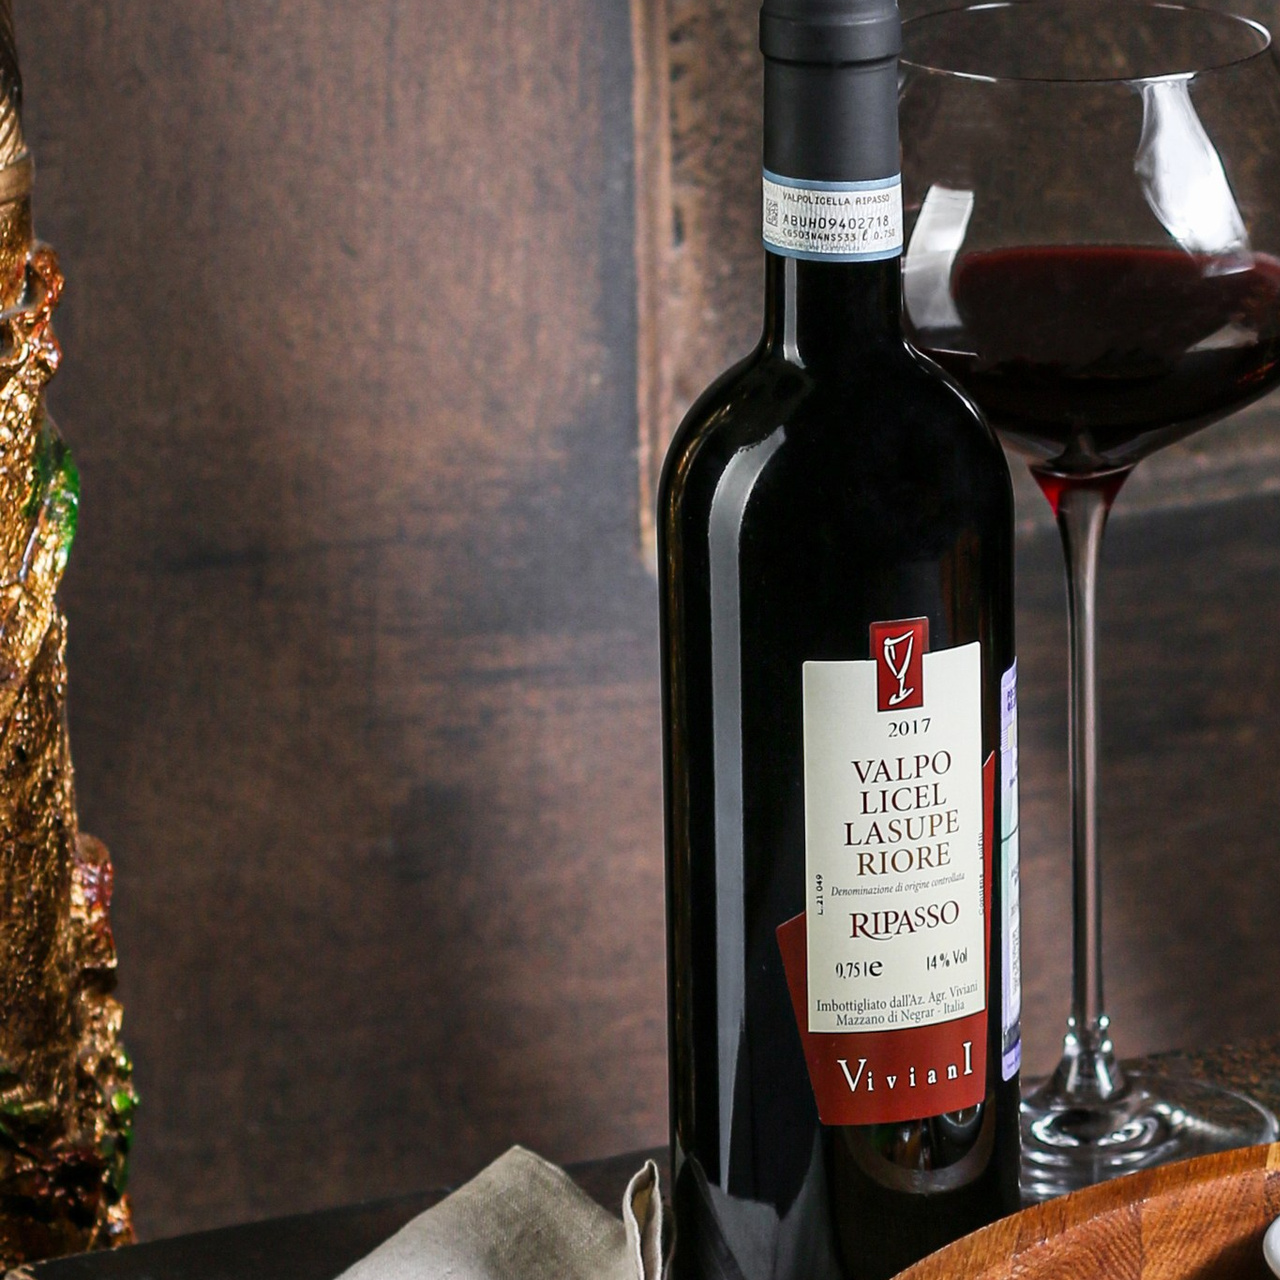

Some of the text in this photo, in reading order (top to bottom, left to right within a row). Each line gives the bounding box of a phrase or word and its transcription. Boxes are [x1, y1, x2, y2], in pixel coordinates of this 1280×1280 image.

[782, 192, 890, 206] VALPOLICELLA RIPASSO
[887, 717, 931, 738] 2017
[850, 750, 952, 784] VALPO
[859, 782, 947, 815] LICEL
[843, 808, 960, 846] LASUPE
[856, 841, 951, 876] RIORE
[815, 874, 824, 892] 049
[831, 872, 965, 897] Denominazione di origine controllata
[848, 900, 959, 941] RIPASSO
[926, 947, 968, 971] 14 % Vol
[816, 999, 887, 1015] Imbottigliato
[928, 991, 947, 1005] Agr.
[949, 980, 978, 998] Viviani
[836, 1012, 885, 1026] Mazzano
[887, 1010, 898, 1023] di
[900, 1008, 934, 1023] Negrar
[943, 1000, 965, 1014] Italia
